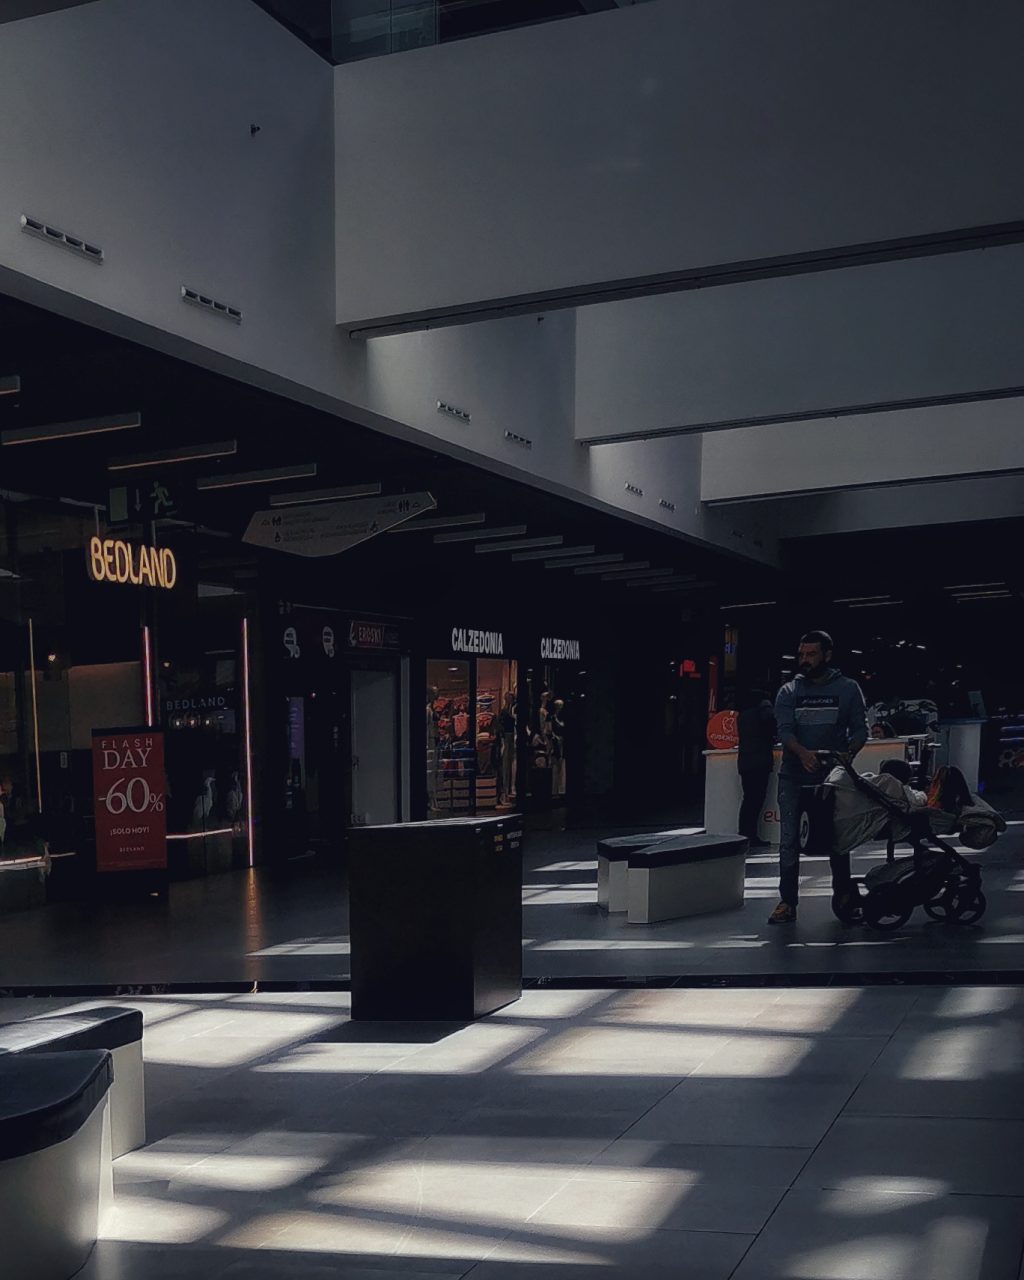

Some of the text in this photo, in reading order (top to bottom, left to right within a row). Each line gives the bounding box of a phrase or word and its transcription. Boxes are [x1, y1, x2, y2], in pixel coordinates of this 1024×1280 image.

[90, 536, 177, 589] BEDLAND
[451, 627, 504, 655] CALZEDONIA
[540, 637, 581, 660] CALZEDONIA
[166, 696, 225, 711] BEDLAND
[101, 737, 153, 749] FLASH
[102, 747, 153, 770] DAY
